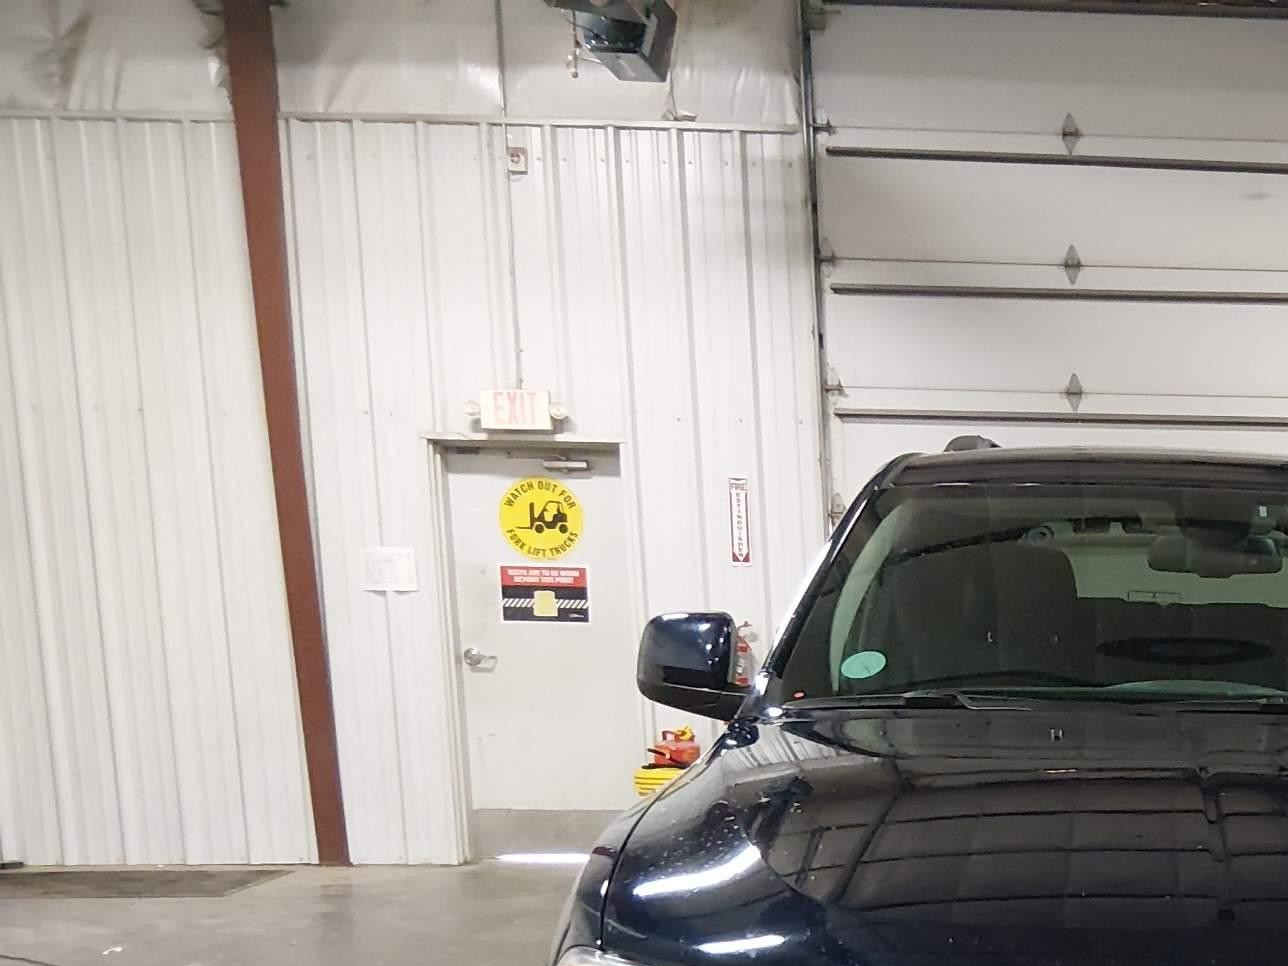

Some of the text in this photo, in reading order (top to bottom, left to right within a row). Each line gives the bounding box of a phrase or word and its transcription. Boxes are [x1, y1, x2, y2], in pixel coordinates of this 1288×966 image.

[493, 391, 537, 425] EXIT
[504, 480, 577, 509] WATCH OUT FOR
[506, 529, 579, 557] FORK LIFT TRUCKS
